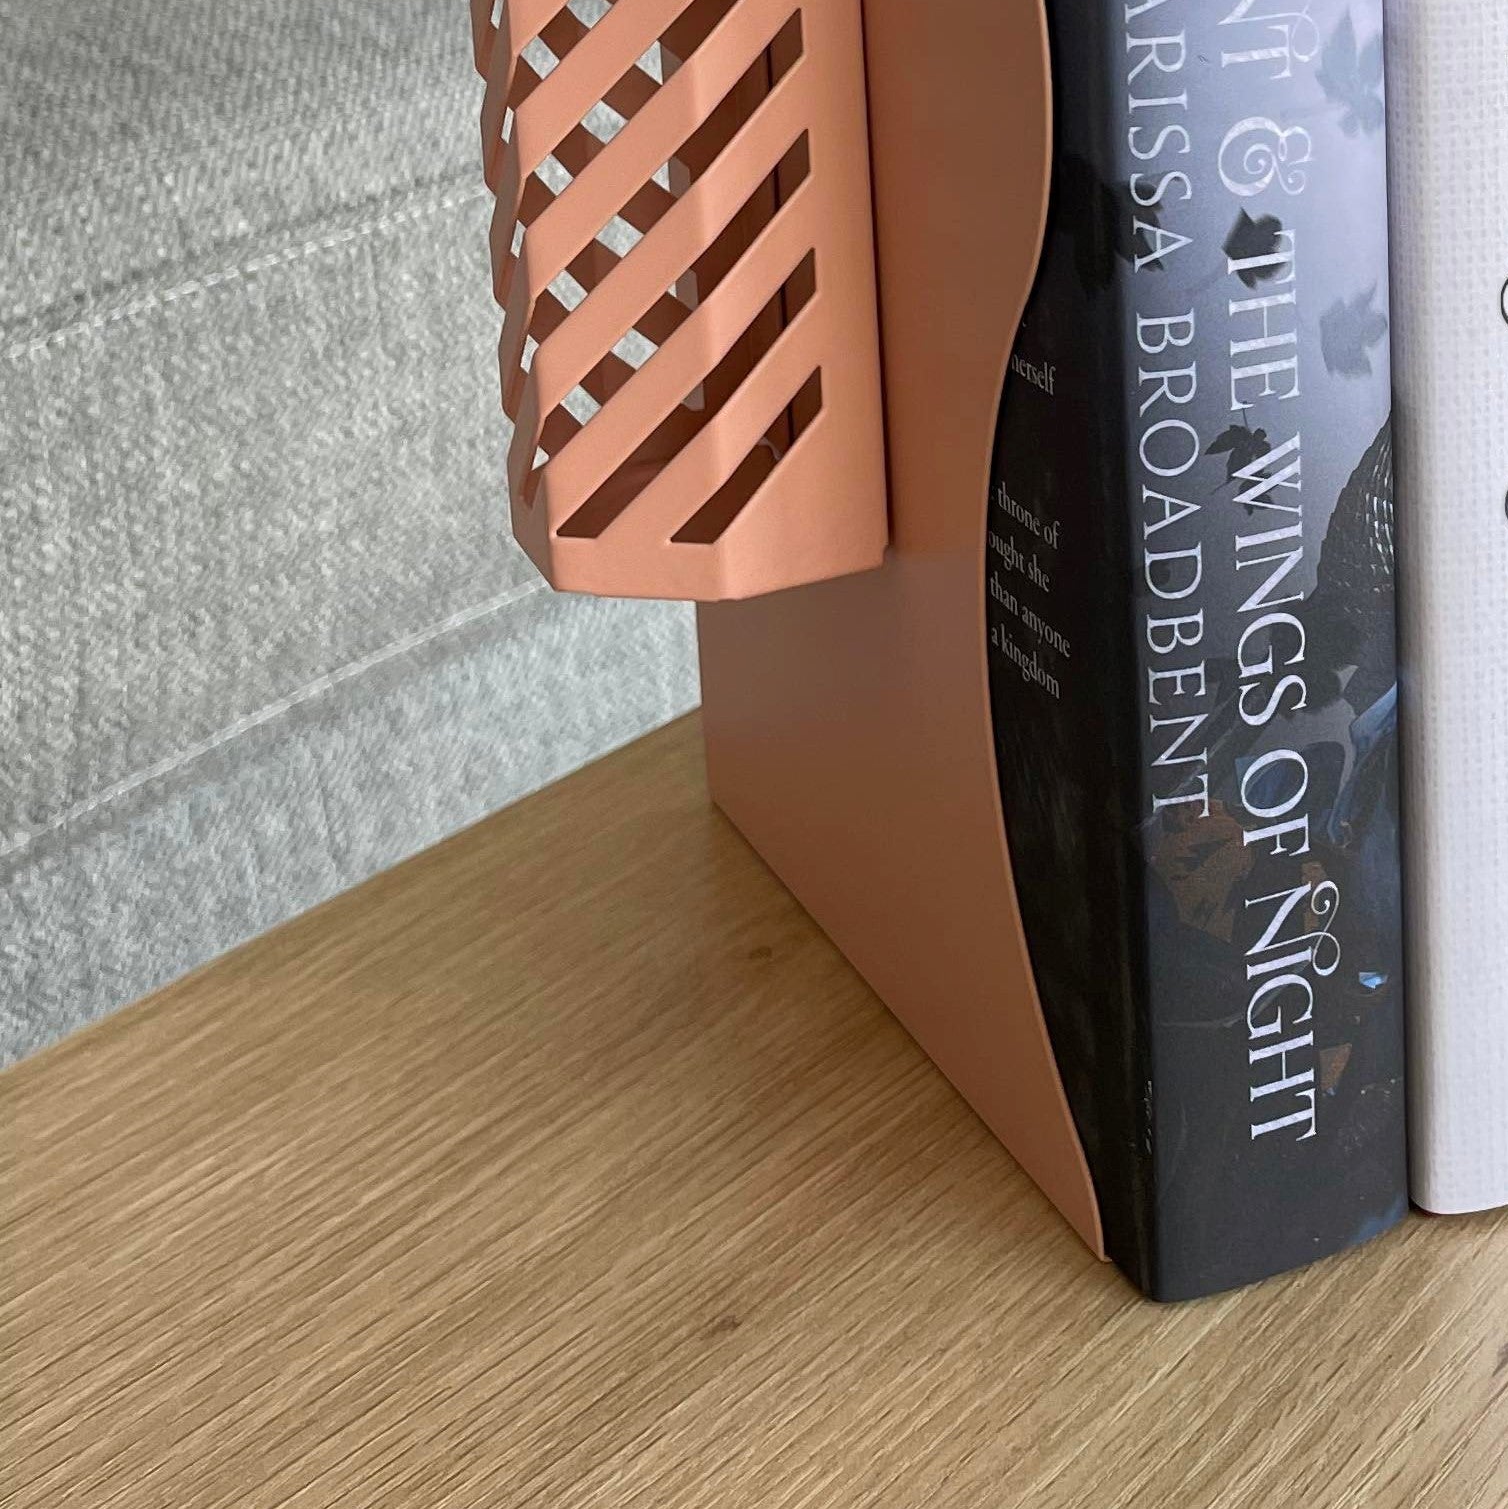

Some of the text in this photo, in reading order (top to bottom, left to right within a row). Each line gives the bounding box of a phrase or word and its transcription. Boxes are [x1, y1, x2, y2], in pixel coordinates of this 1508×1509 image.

[1227, 228, 1302, 411] THE
[997, 480, 1061, 550] throne of
[1136, 307, 1210, 818] BROADBENT
[989, 570, 1072, 658] than anyone
[1027, 553, 1050, 593] she
[1232, 430, 1308, 727] WINGS
[1000, 622, 1060, 700] kingdom
[1240, 748, 1311, 857] OF
[1244, 879, 1341, 1142] NIGHT
